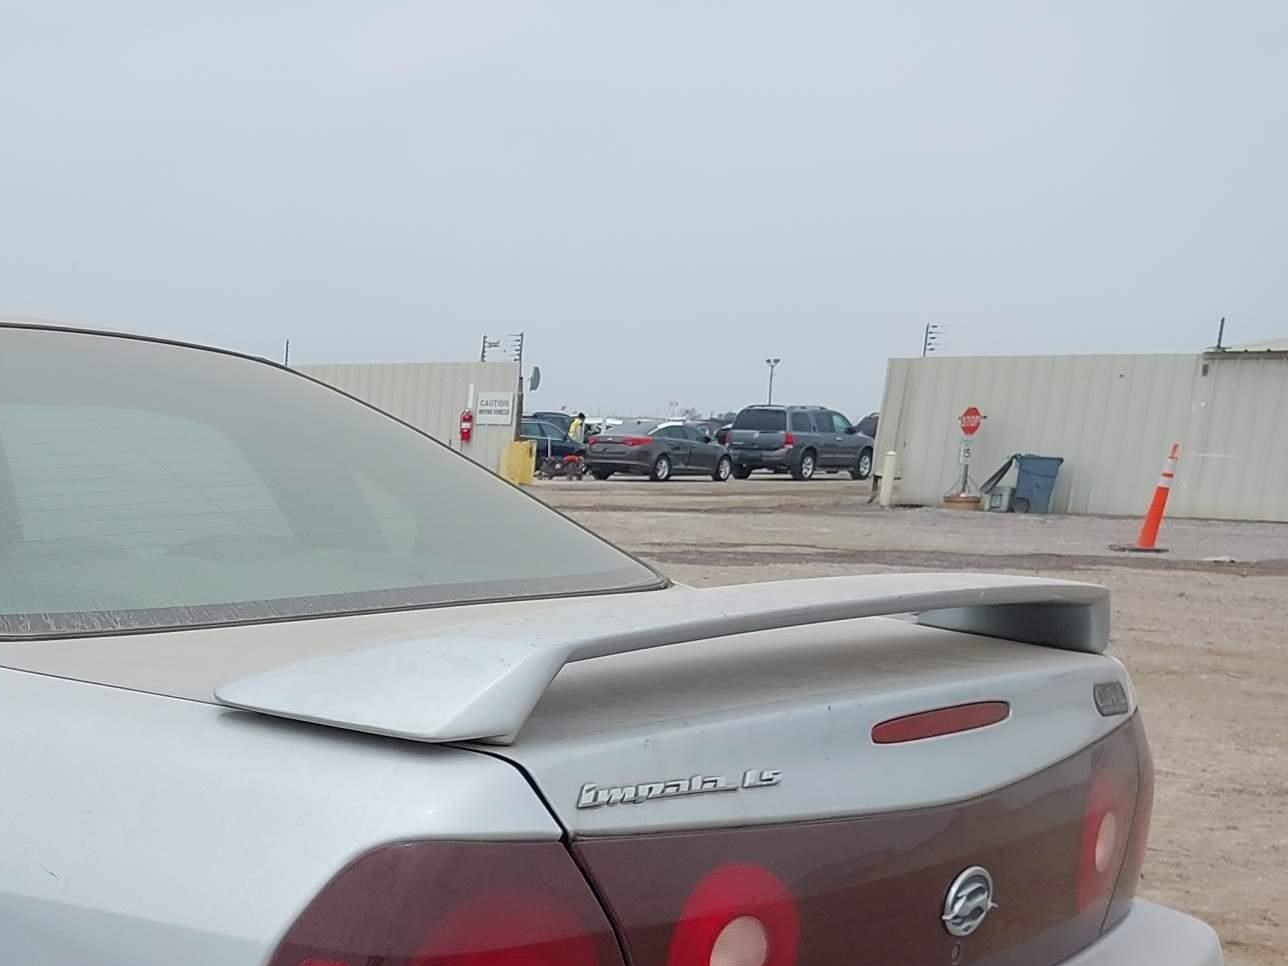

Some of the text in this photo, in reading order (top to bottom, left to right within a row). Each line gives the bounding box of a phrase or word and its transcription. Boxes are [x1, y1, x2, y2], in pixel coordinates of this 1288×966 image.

[479, 399, 510, 408] CAUTION
[577, 769, 782, 809] Impala LS
